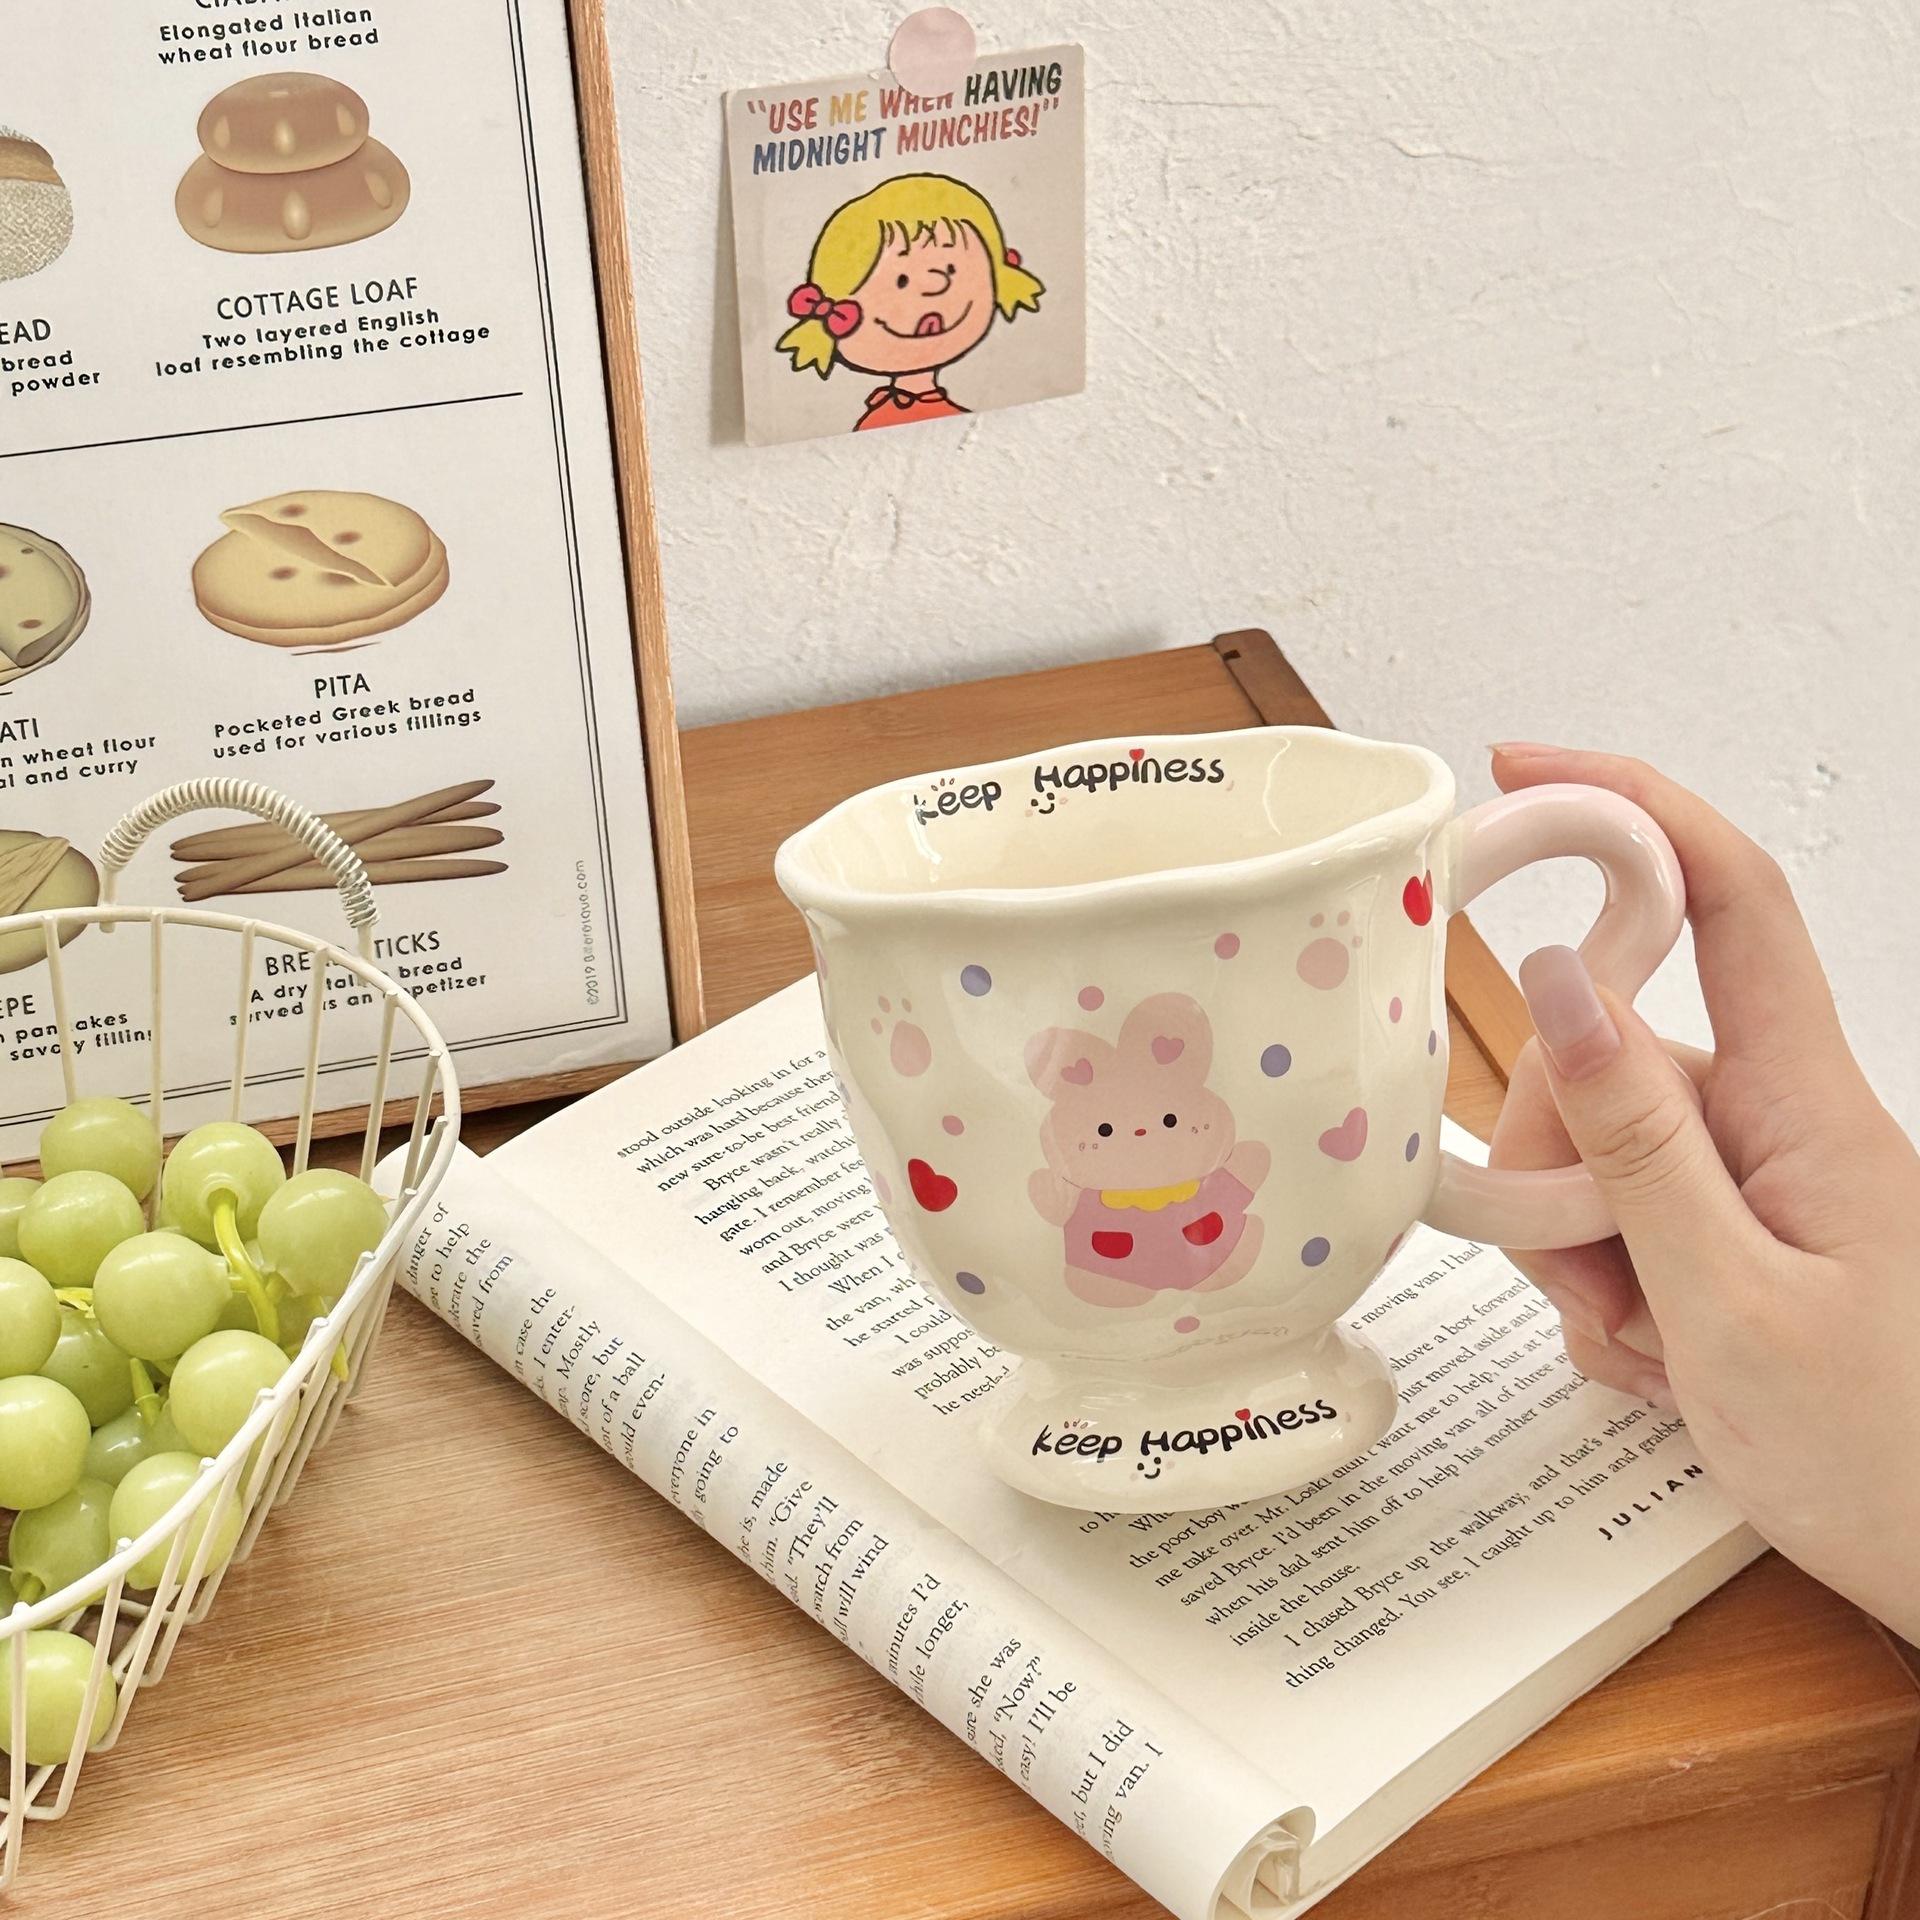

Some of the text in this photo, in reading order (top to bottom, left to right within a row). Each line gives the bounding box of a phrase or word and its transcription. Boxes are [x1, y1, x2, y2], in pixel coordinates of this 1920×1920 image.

[158, 28, 379, 64] wheat flour bread
[160, 9, 372, 41] Elongated Italian
[830, 90, 868, 126] ME
[965, 62, 1062, 106] HAVING
[753, 127, 887, 175] MIDNIGHT
[216, 277, 418, 320] COTTAGE LOAF
[155, 326, 490, 376] loaf resembling the cottage
[202, 309, 439, 349] Two layered English
[1, 351, 73, 372] bread
[12, 372, 101, 396] powder
[314, 673, 370, 698] PITA
[213, 710, 482, 758] used for various fillings
[214, 689, 475, 738] Pocketed Greek bread
[23, 742, 94, 764] wheat
[103, 737, 156, 754] flour
[25, 767, 68, 785] and
[79, 760, 138, 774] curry
[1034, 749, 1224, 792] Happiness
[266, 930, 440, 976] BRETICKS
[251, 957, 462, 1003] A dry bread
[16, 1013, 128, 1043] panakes
[230, 993, 372, 1026] srved an
[10, 1040, 85, 1061] savoy
[617, 1056, 813, 1158] stood outside looking in for
[637, 1086, 804, 1174] which was hard because
[658, 1113, 798, 1190] new sure-to-be best
[703, 1118, 841, 1191] Bryce really
[433, 1202, 449, 1223] of
[695, 1185, 763, 1226] hanging
[768, 1170, 841, 1212] remember
[436, 1223, 469, 1259] help
[740, 1183, 872, 1256] worn moving
[762, 1209, 874, 1274] and Bryce were
[466, 1238, 491, 1265] the
[479, 1255, 513, 1294] from
[793, 1233, 884, 1286] thought was
[531, 1288, 556, 1314] the
[828, 1267, 883, 1294] When
[1362, 1243, 1484, 1323] moving had
[825, 1313, 854, 1331] the
[843, 1300, 923, 1347] he started
[910, 1309, 951, 1339] could
[1389, 1278, 1530, 1371] shove box forward
[1427, 1305, 1540, 1383] moved and
[557, 1320, 601, 1380] Mostly
[592, 1336, 624, 1365] but
[613, 1352, 646, 1386] ball
[891, 1358, 923, 1377] was
[914, 1355, 981, 1399] probably
[694, 1408, 717, 1427] in
[933, 1400, 960, 1415] he
[1140, 1399, 1337, 1454] Happiness
[695, 1449, 723, 1504] going
[720, 1425, 739, 1444] to
[751, 1461, 788, 1509] made
[1155, 1567, 1183, 1587] me
[1182, 1546, 1219, 1570] take
[1377, 1421, 1416, 1449] want
[1415, 1406, 1441, 1424] me
[1440, 1393, 1458, 1407] to
[1491, 1350, 1524, 1370] but
[1180, 1362, 1555, 1607] saved Bryce. been the moving van all three
[1206, 1408, 1539, 1627] when his dad sent him off help his mother
[1303, 1408, 1646, 1638] chased Bryce the walkway, and when
[1599, 1464, 1703, 1541] JULIAN
[825, 1518, 864, 1561] from
[852, 1534, 889, 1580] wind
[1129, 1509, 1226, 1569] the poor boy
[1286, 1448, 1639, 1689] thing changed. You caught him and
[1230, 1563, 1361, 1646] inside the house.
[916, 1599, 968, 1659] longer,
[968, 1674, 992, 1708] she
[990, 1638, 1022, 1670] was
[1049, 1681, 1077, 1703] be
[1071, 1768, 1098, 1804] but
[1104, 1719, 1134, 1753] did
